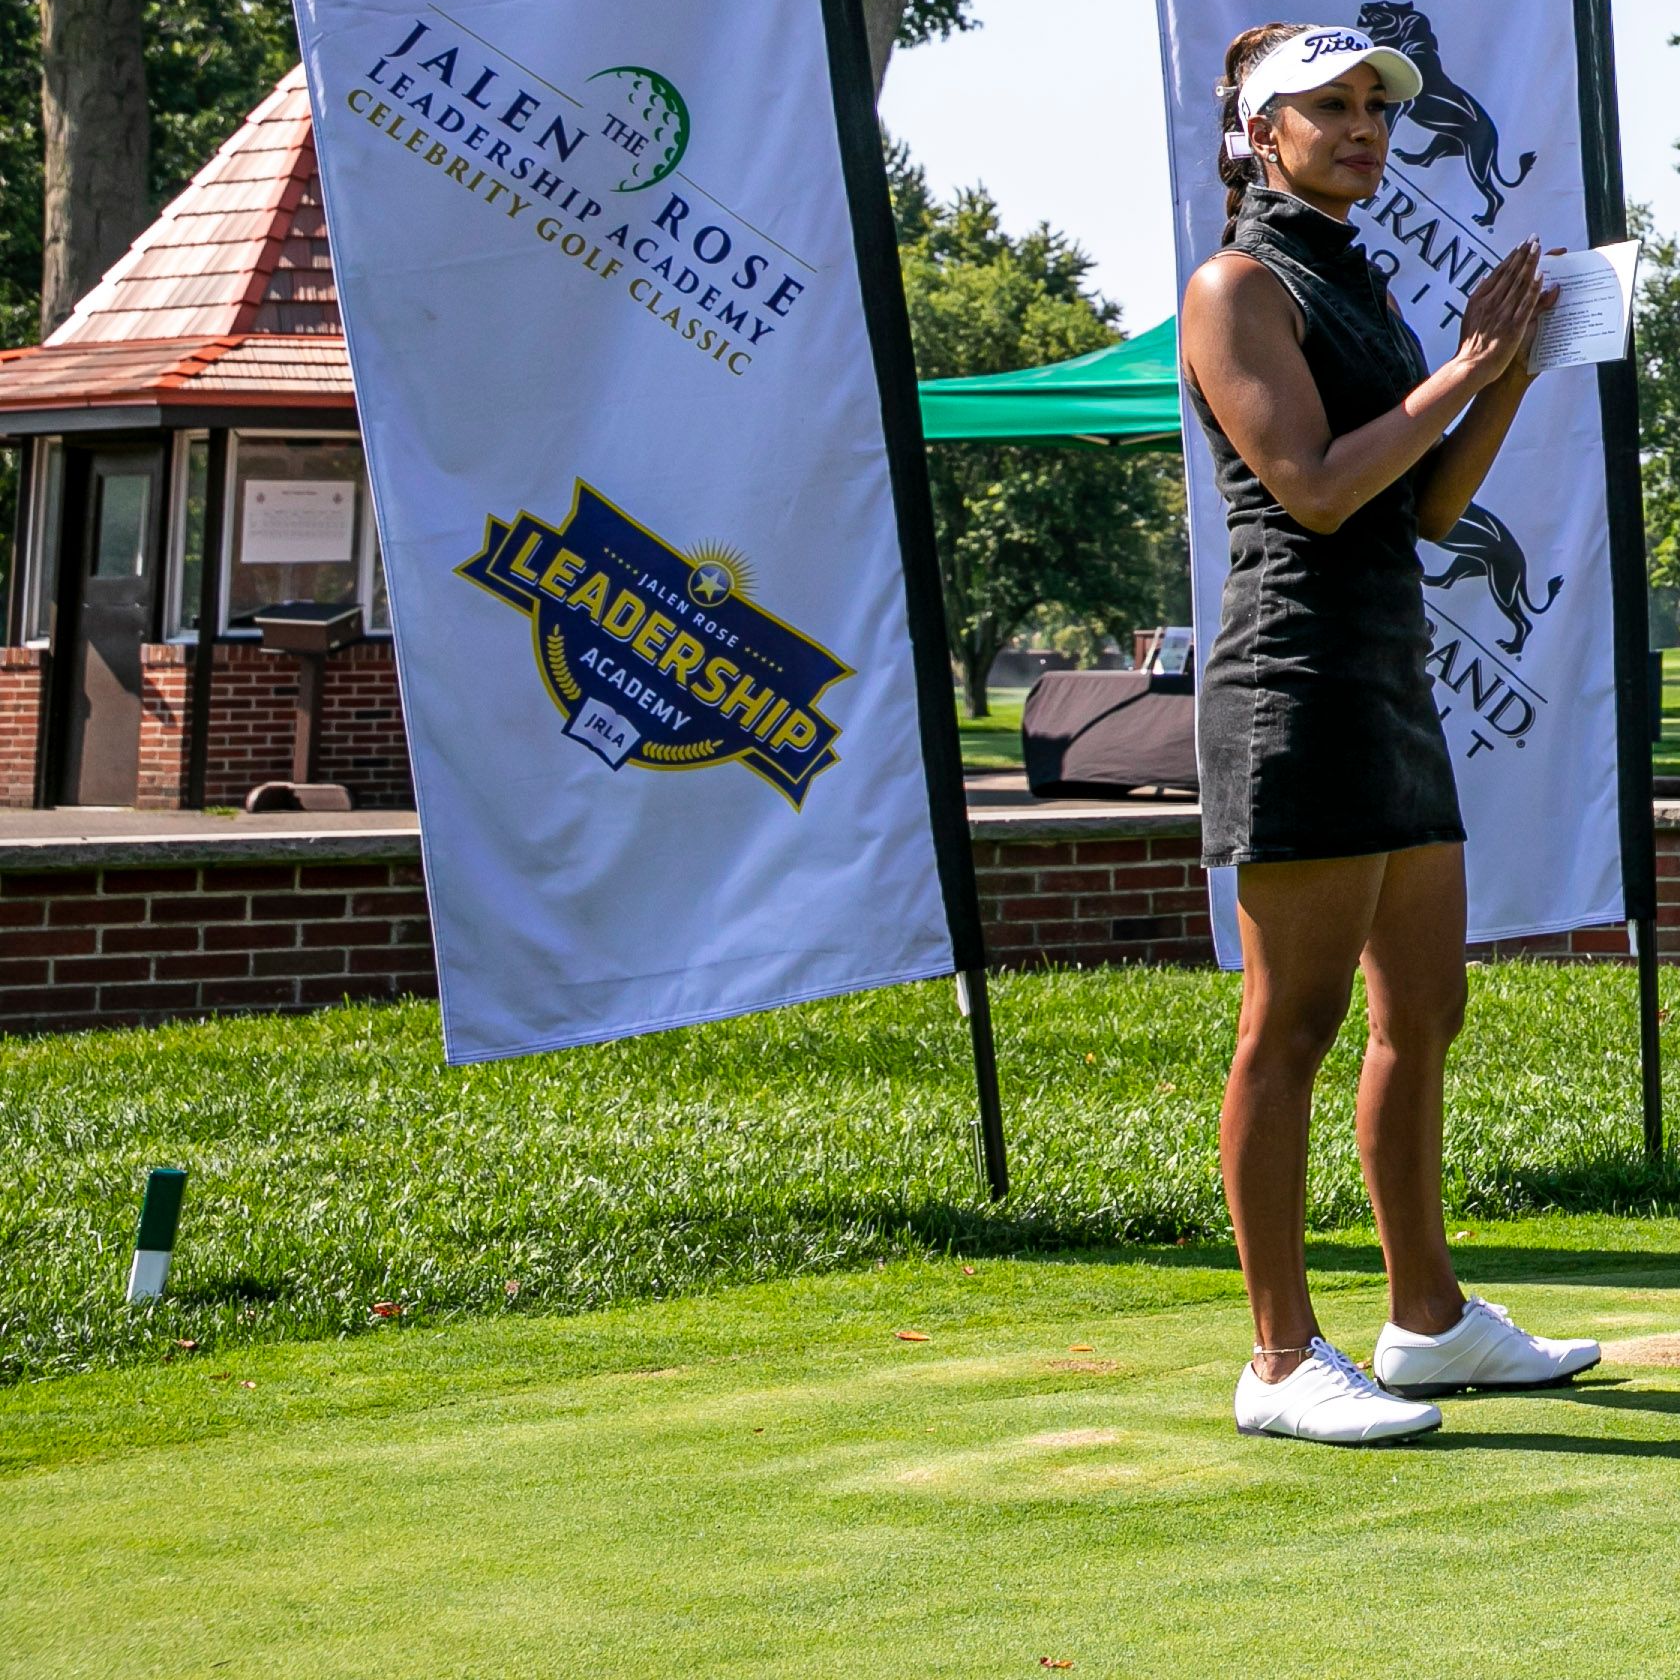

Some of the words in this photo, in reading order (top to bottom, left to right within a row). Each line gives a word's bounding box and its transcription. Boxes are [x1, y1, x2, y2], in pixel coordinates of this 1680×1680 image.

[347, 88, 531, 217] CELEBRITY
[536, 216, 626, 281] GOLF
[628, 278, 754, 377] CLASSIC
[367, 59, 604, 218] LEADERSHIP
[607, 224, 776, 346] ACADEMY
[386, 20, 589, 162] JALEN
[601, 113, 650, 156] THE
[653, 193, 807, 315] ROSE
[508, 531, 818, 754] LEADERSHIP
[580, 646, 692, 732] ACADEMY
[638, 572, 690, 615] JALEN
[694, 608, 740, 649] ROSE
[584, 712, 626, 749] JRLA
